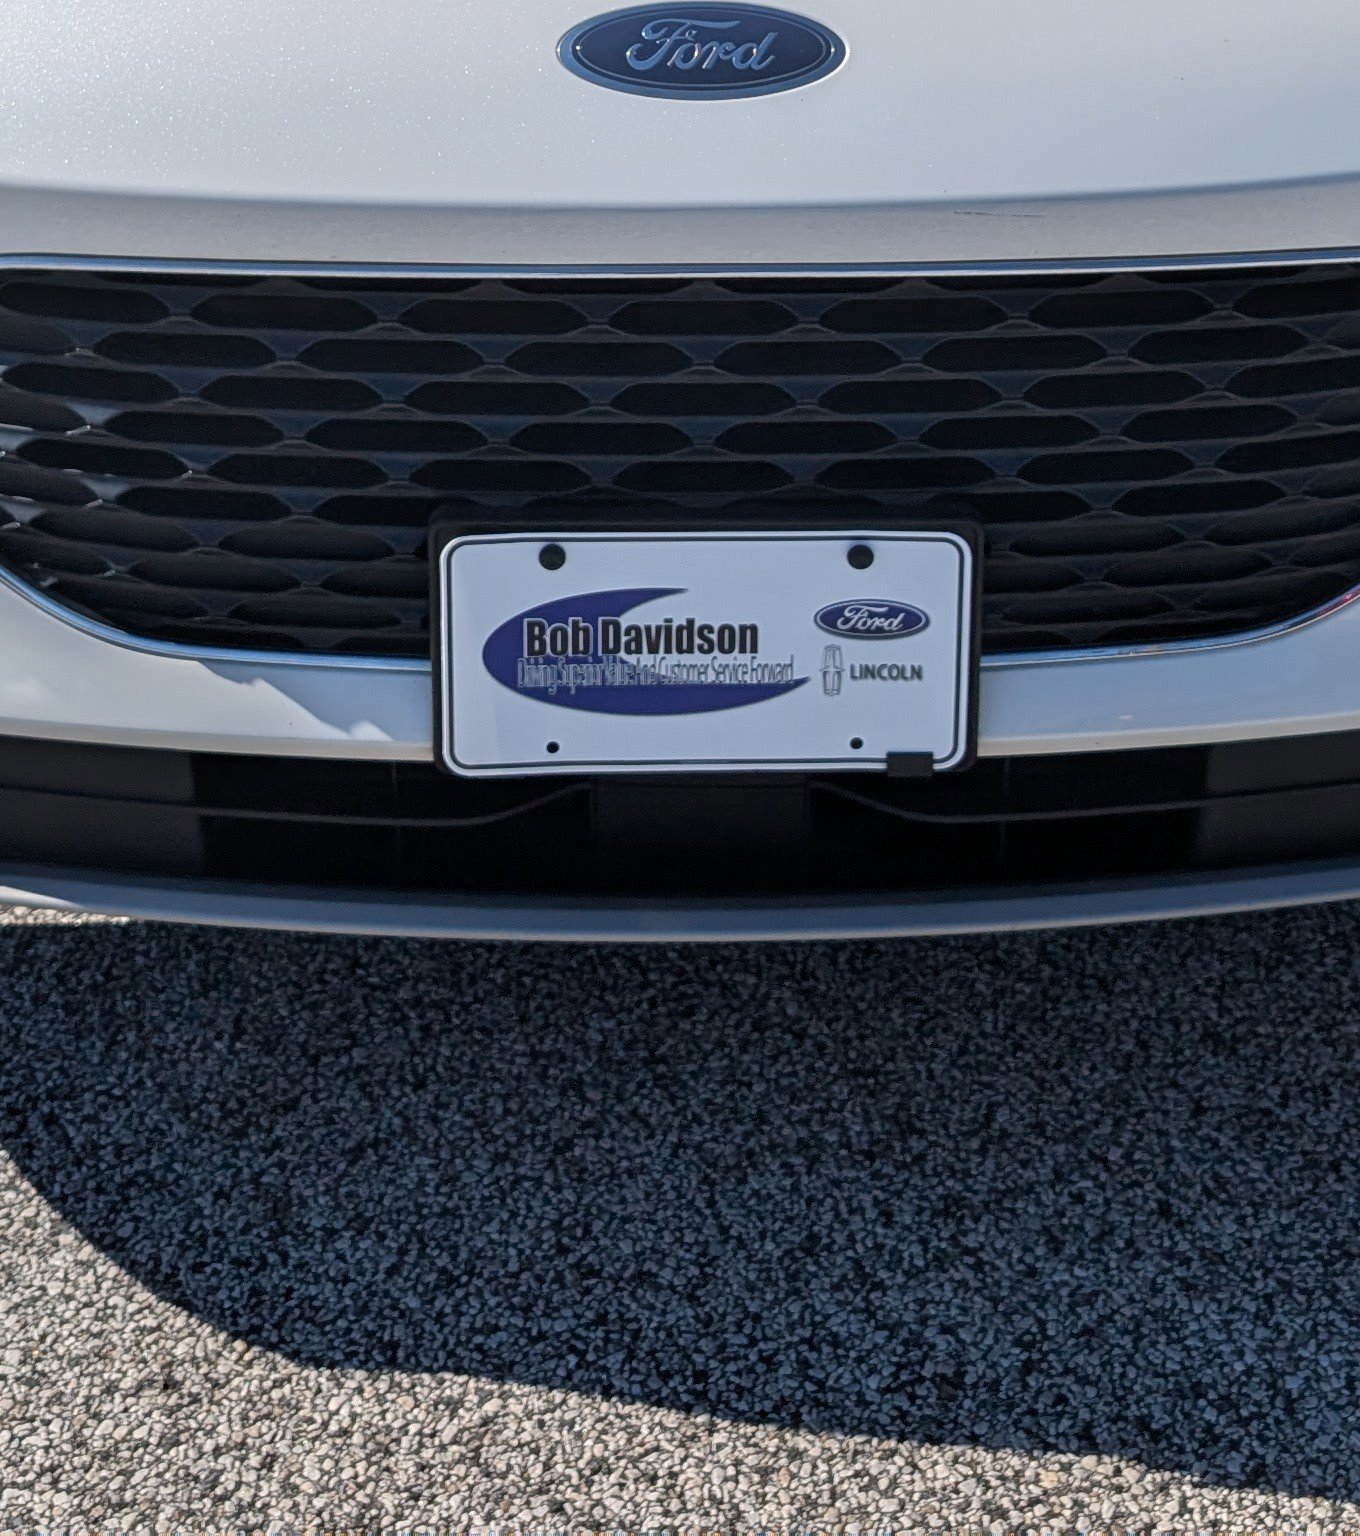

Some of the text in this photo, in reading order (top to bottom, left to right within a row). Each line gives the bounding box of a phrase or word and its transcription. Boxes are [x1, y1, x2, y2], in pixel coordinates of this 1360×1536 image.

[626, 18, 779, 70] Ford
[836, 604, 906, 631] Ford
[522, 616, 759, 657] Bob Davidson
[658, 656, 710, 685] Customer
[710, 656, 749, 685] Service
[750, 654, 795, 684] Forward
[849, 662, 923, 682] LINCOLN
